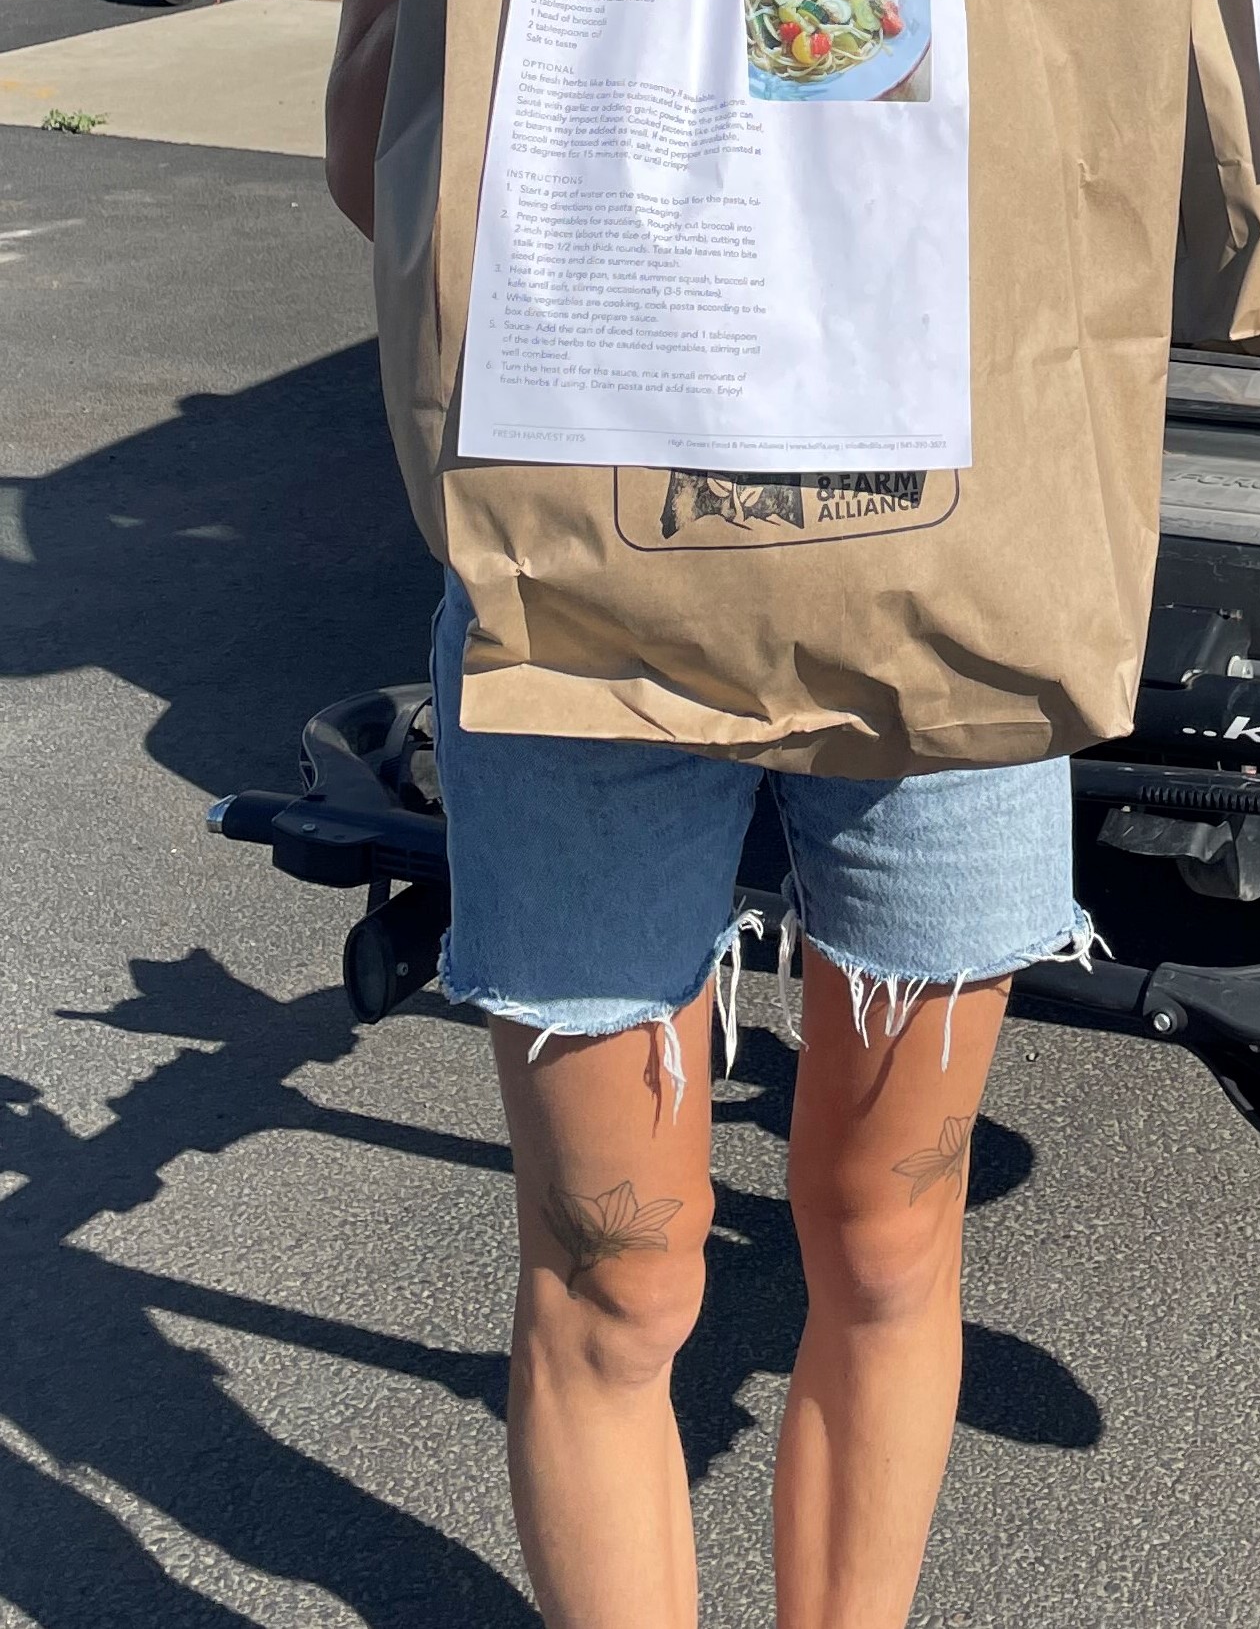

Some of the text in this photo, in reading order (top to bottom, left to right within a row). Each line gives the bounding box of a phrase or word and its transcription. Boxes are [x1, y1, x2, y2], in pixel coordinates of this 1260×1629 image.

[537, 9, 607, 26] head of broccoli
[527, 20, 589, 37] 2 tablespoons
[526, 33, 577, 49] Salt to taste
[523, 59, 574, 74] OPTIONAL
[521, 71, 676, 97] Use fresh herbs rosemary
[518, 83, 543, 94] Other
[547, 89, 594, 100] vegetables
[613, 90, 624, 99] be
[627, 91, 673, 107] substituted
[684, 105, 696, 114] the
[515, 109, 661, 128] additionally impact Cooked
[601, 103, 632, 113] adding
[634, 105, 658, 114] garlic
[659, 111, 685, 124] powder
[526, 121, 552, 132] beans
[554, 127, 573, 136] may
[575, 126, 586, 134] be
[588, 126, 616, 135] added
[669, 137, 689, 147] oven
[512, 130, 547, 143] broccoli
[550, 137, 569, 148] may
[670, 150, 701, 160] pepper
[511, 143, 661, 166] 425 degrees for 15 until
[507, 169, 584, 185] INSTRUCTIONS
[520, 185, 634, 199] Start pot the
[518, 196, 592, 211] lowing directions
[517, 212, 537, 224] Prep
[540, 216, 588, 226] vegetables
[589, 216, 601, 225] for
[647, 219, 682, 231] Roughly
[701, 221, 734, 231] broccoli
[544, 229, 740, 246] pieces the cutting
[557, 242, 757, 259] 1/2 Tear leaves into bite
[537, 255, 644, 266] pieces summer
[509, 265, 764, 286] Heat large summer squash, broccoli and
[528, 281, 660, 296] until occasionally
[534, 296, 583, 306] vegetables
[644, 301, 667, 309] cook
[670, 303, 694, 312] pasta
[697, 303, 739, 314] according
[753, 305, 766, 313] the
[505, 306, 628, 323] box directions and prepare
[536, 323, 757, 342] Add the can of tomatoes and tablespoon
[515, 335, 529, 344] the
[531, 336, 555, 345] dried
[558, 337, 584, 347] herbs
[599, 339, 614, 348] the
[655, 343, 707, 353] vegetables,
[742, 345, 761, 354] until
[501, 361, 735, 381] Turn the off for amounts
[500, 374, 522, 384] fresh
[524, 377, 550, 386] herbs
[590, 379, 615, 389] Drain
[665, 384, 683, 393] add
[717, 386, 743, 397] Enjoy!
[492, 429, 586, 442] FRESH HARVEST KITS
[818, 491, 919, 522] ALLIANCE
